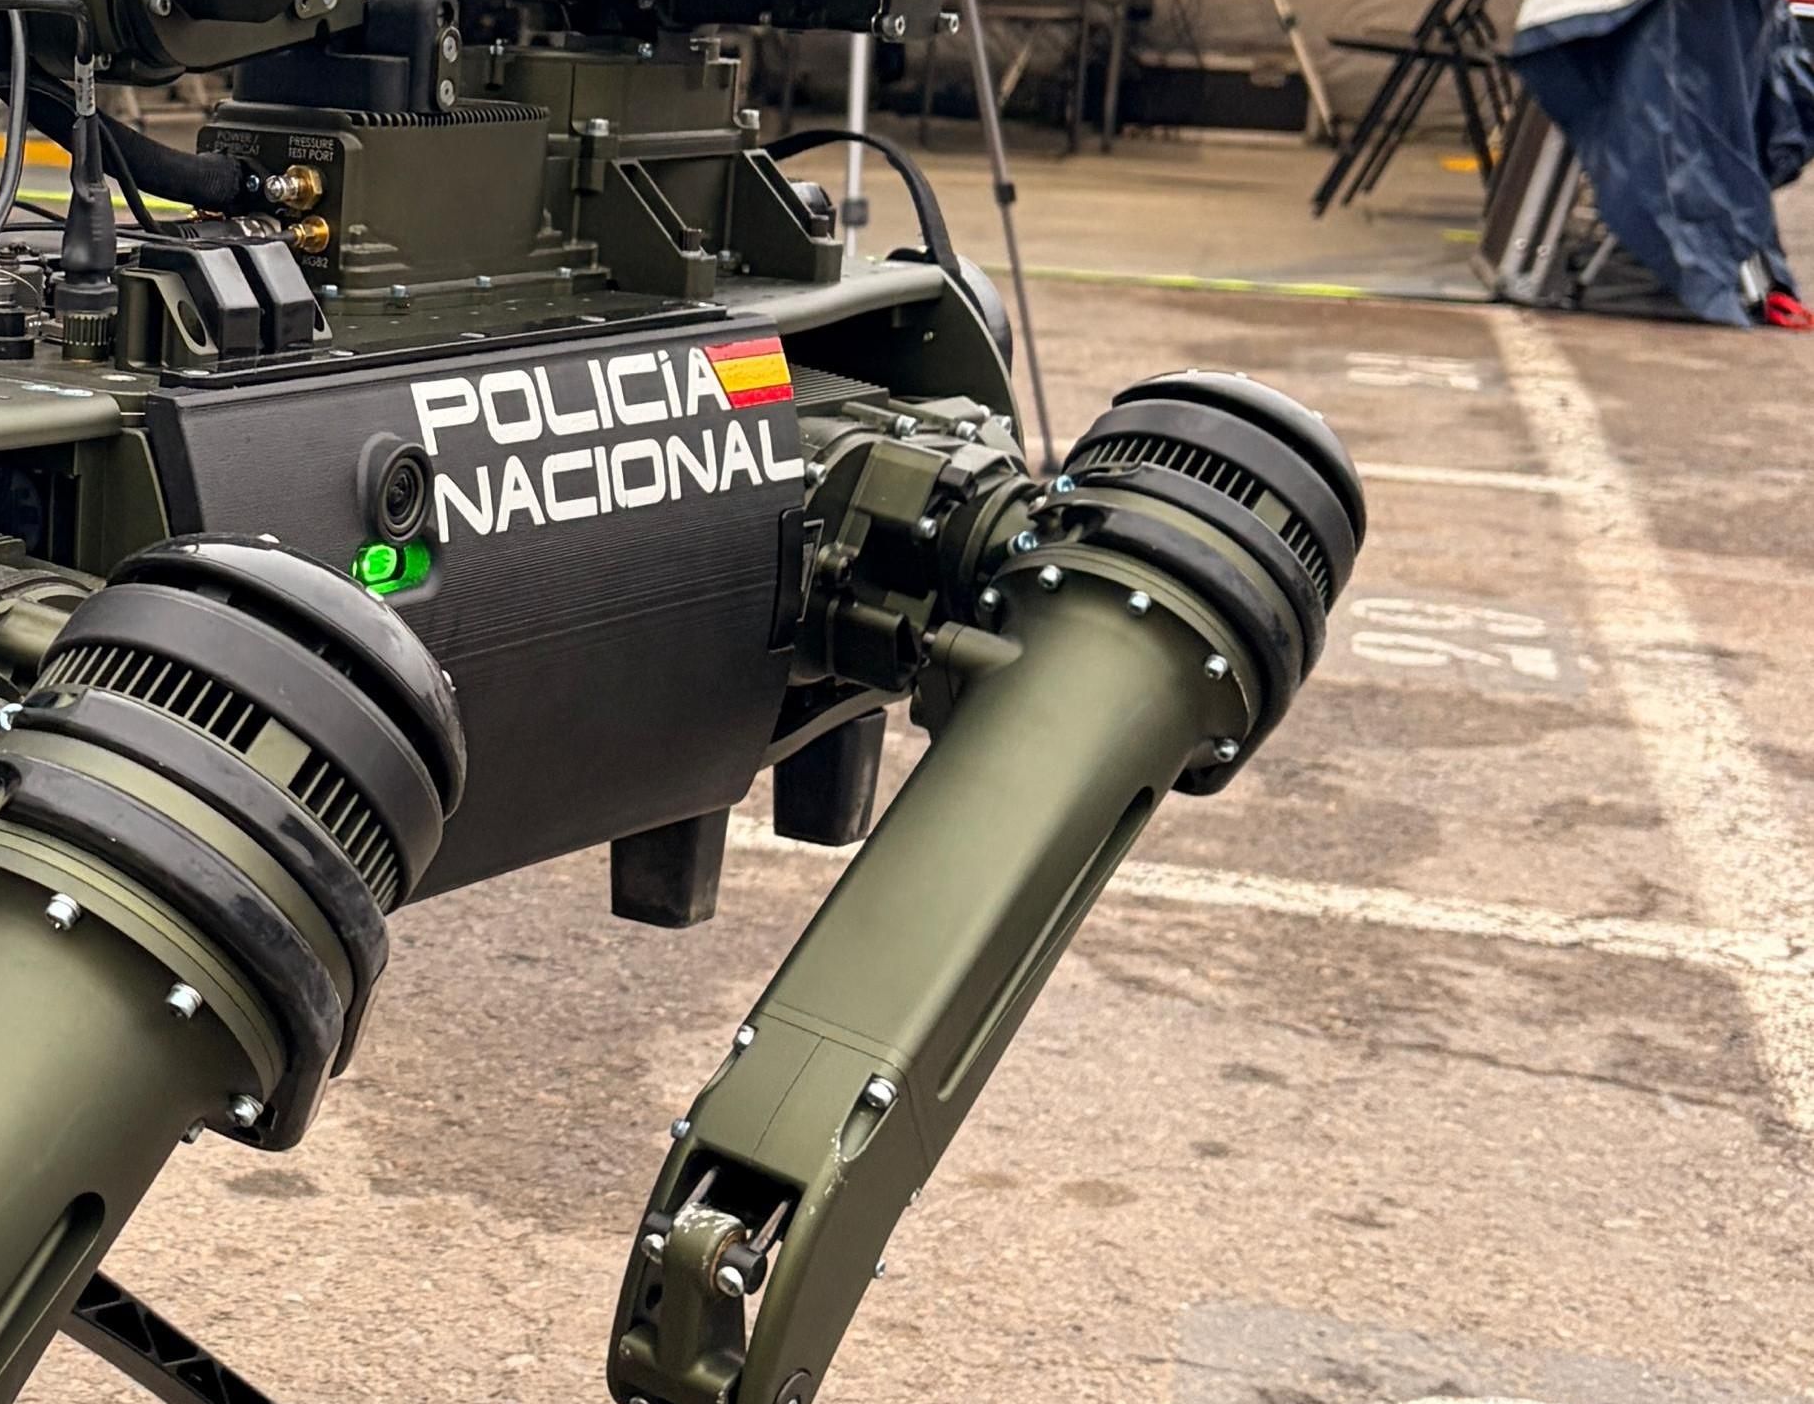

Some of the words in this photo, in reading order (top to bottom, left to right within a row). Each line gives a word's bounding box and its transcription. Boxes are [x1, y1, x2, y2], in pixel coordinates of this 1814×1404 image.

[288, 135, 335, 151] PRESSURE
[288, 146, 307, 160] TEST
[308, 149, 335, 163] PORT
[434, 419, 805, 544] NACIONAL
